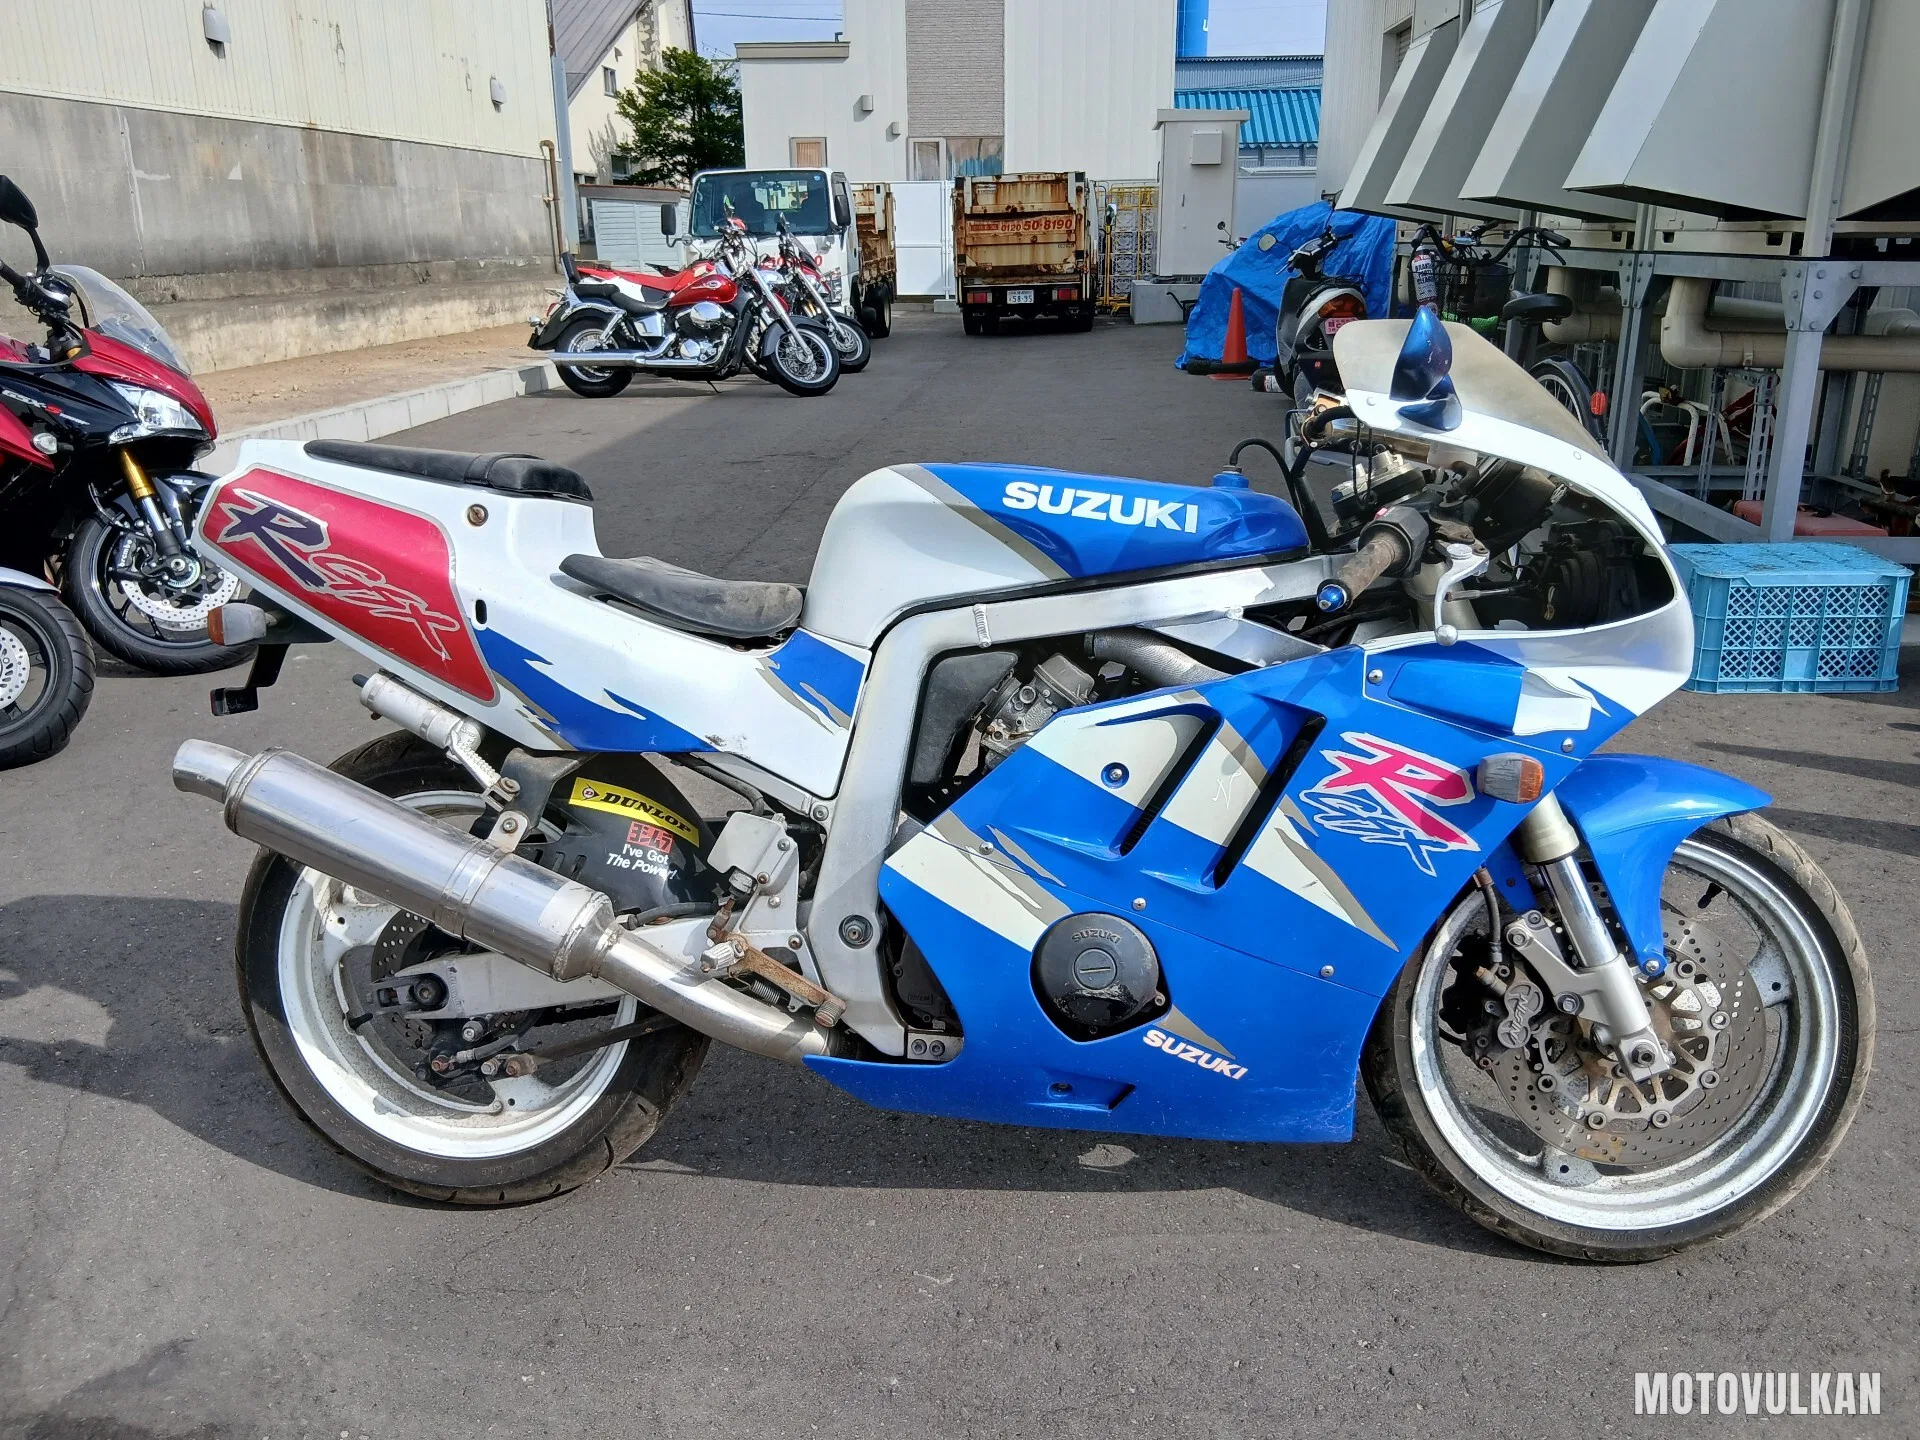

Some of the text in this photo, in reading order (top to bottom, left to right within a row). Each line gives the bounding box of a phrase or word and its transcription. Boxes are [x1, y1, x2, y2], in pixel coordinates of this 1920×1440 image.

[1001, 224, 1021, 232] 0120
[1023, 219, 1072, 231] 50-8190
[1002, 481, 1199, 534] SUZUKI
[118, 539, 133, 568] brembo
[216, 487, 332, 595] R
[1312, 731, 1482, 852] R
[600, 791, 692, 833] DUNLOP
[627, 821, 674, 853] ヨシムラ
[606, 853, 678, 880] The Power!
[622, 843, 669, 865] I've Got
[1071, 928, 1121, 944] SUZUKI
[1142, 1029, 1249, 1080] SUZUKI
